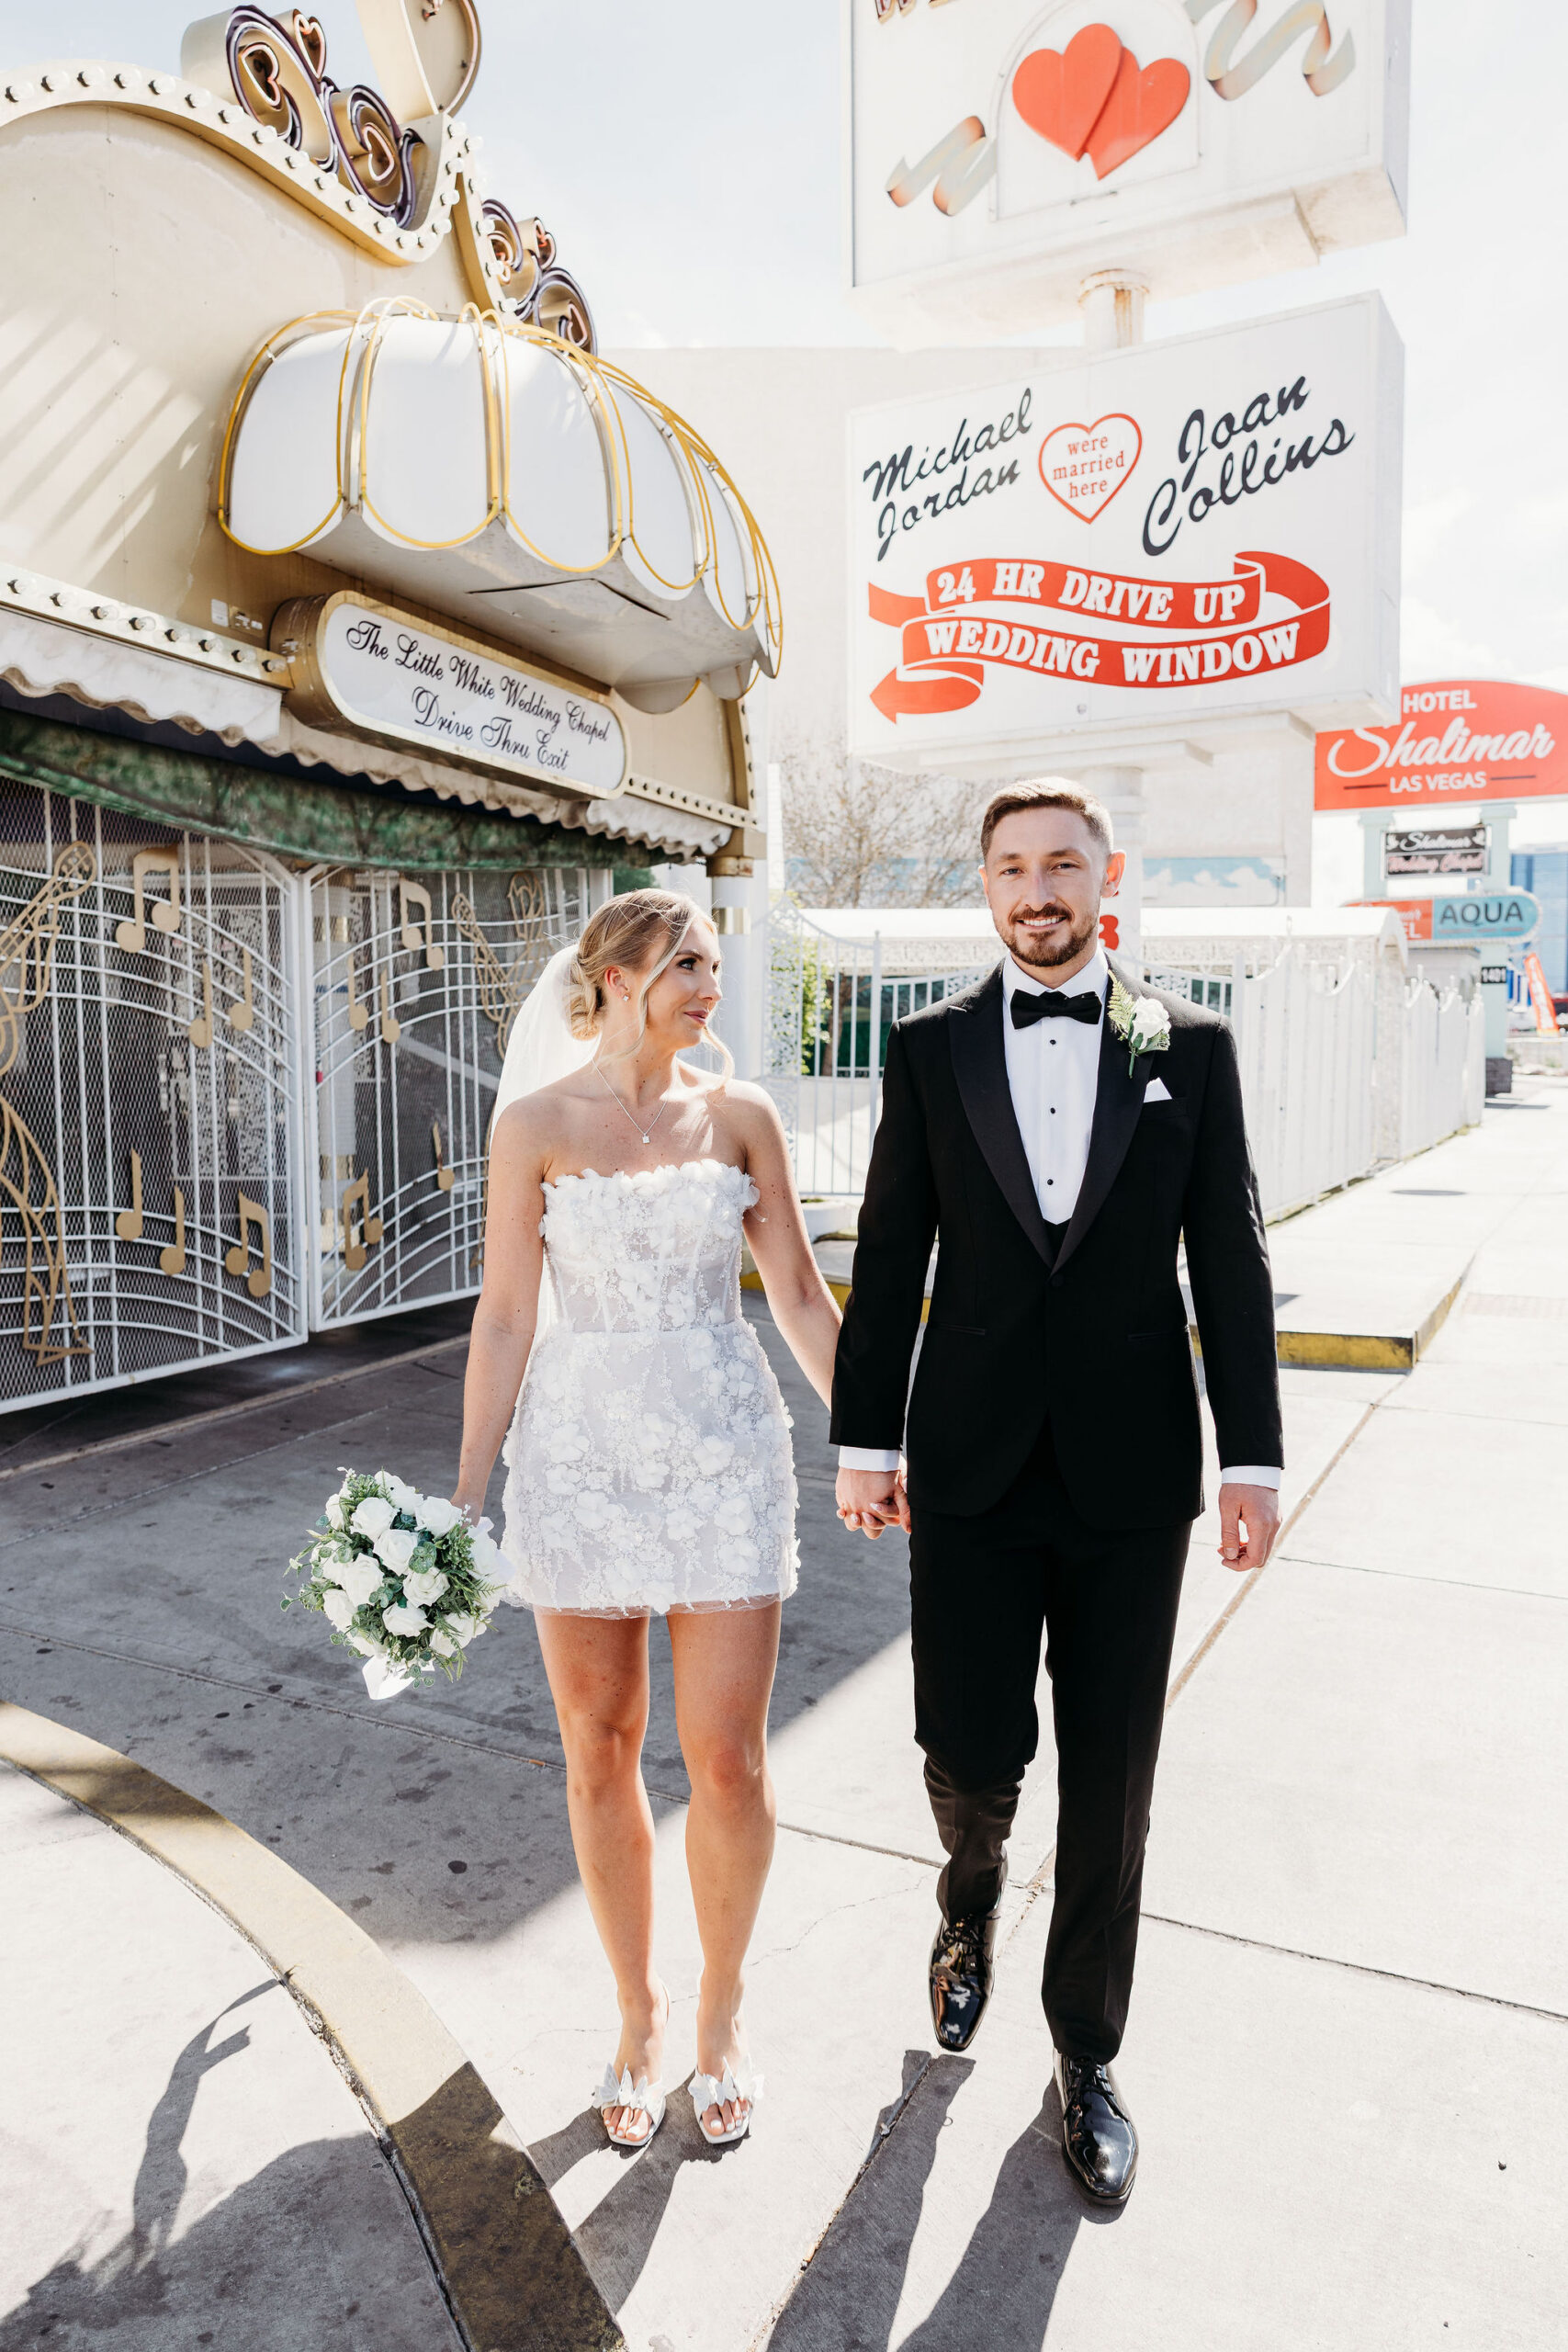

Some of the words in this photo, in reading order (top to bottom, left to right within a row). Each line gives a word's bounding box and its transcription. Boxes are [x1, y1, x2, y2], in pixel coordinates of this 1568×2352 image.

[863, 388, 1032, 502] Michael
[1067, 434, 1109, 455] were
[1178, 376, 1311, 492] Joan
[1053, 451, 1125, 480] married
[1068, 477, 1108, 500] here
[1142, 419, 1355, 557] Collins
[877, 459, 1021, 562] Jordan
[937, 566, 976, 604] 24
[992, 562, 1044, 600] HR
[1058, 570, 1173, 621] DRIVE
[1193, 583, 1246, 621] UP
[924, 620, 1100, 677] WEDDING
[1122, 623, 1300, 683] WINDOW
[346, 620, 389, 661] The
[395, 634, 444, 681] Little
[449, 655, 495, 701] White
[500, 675, 561, 734] Wedding
[566, 701, 611, 745] Chapel
[1403, 689, 1477, 714] HOTEL
[412, 685, 474, 741] Drive
[479, 717, 530, 759] Thru
[536, 729, 570, 771] Exit
[1327, 717, 1556, 778] Shalimar
[1390, 775, 1422, 794] LAS
[1426, 771, 1486, 791] VEGAS
[1439, 901, 1523, 927] AQUA
